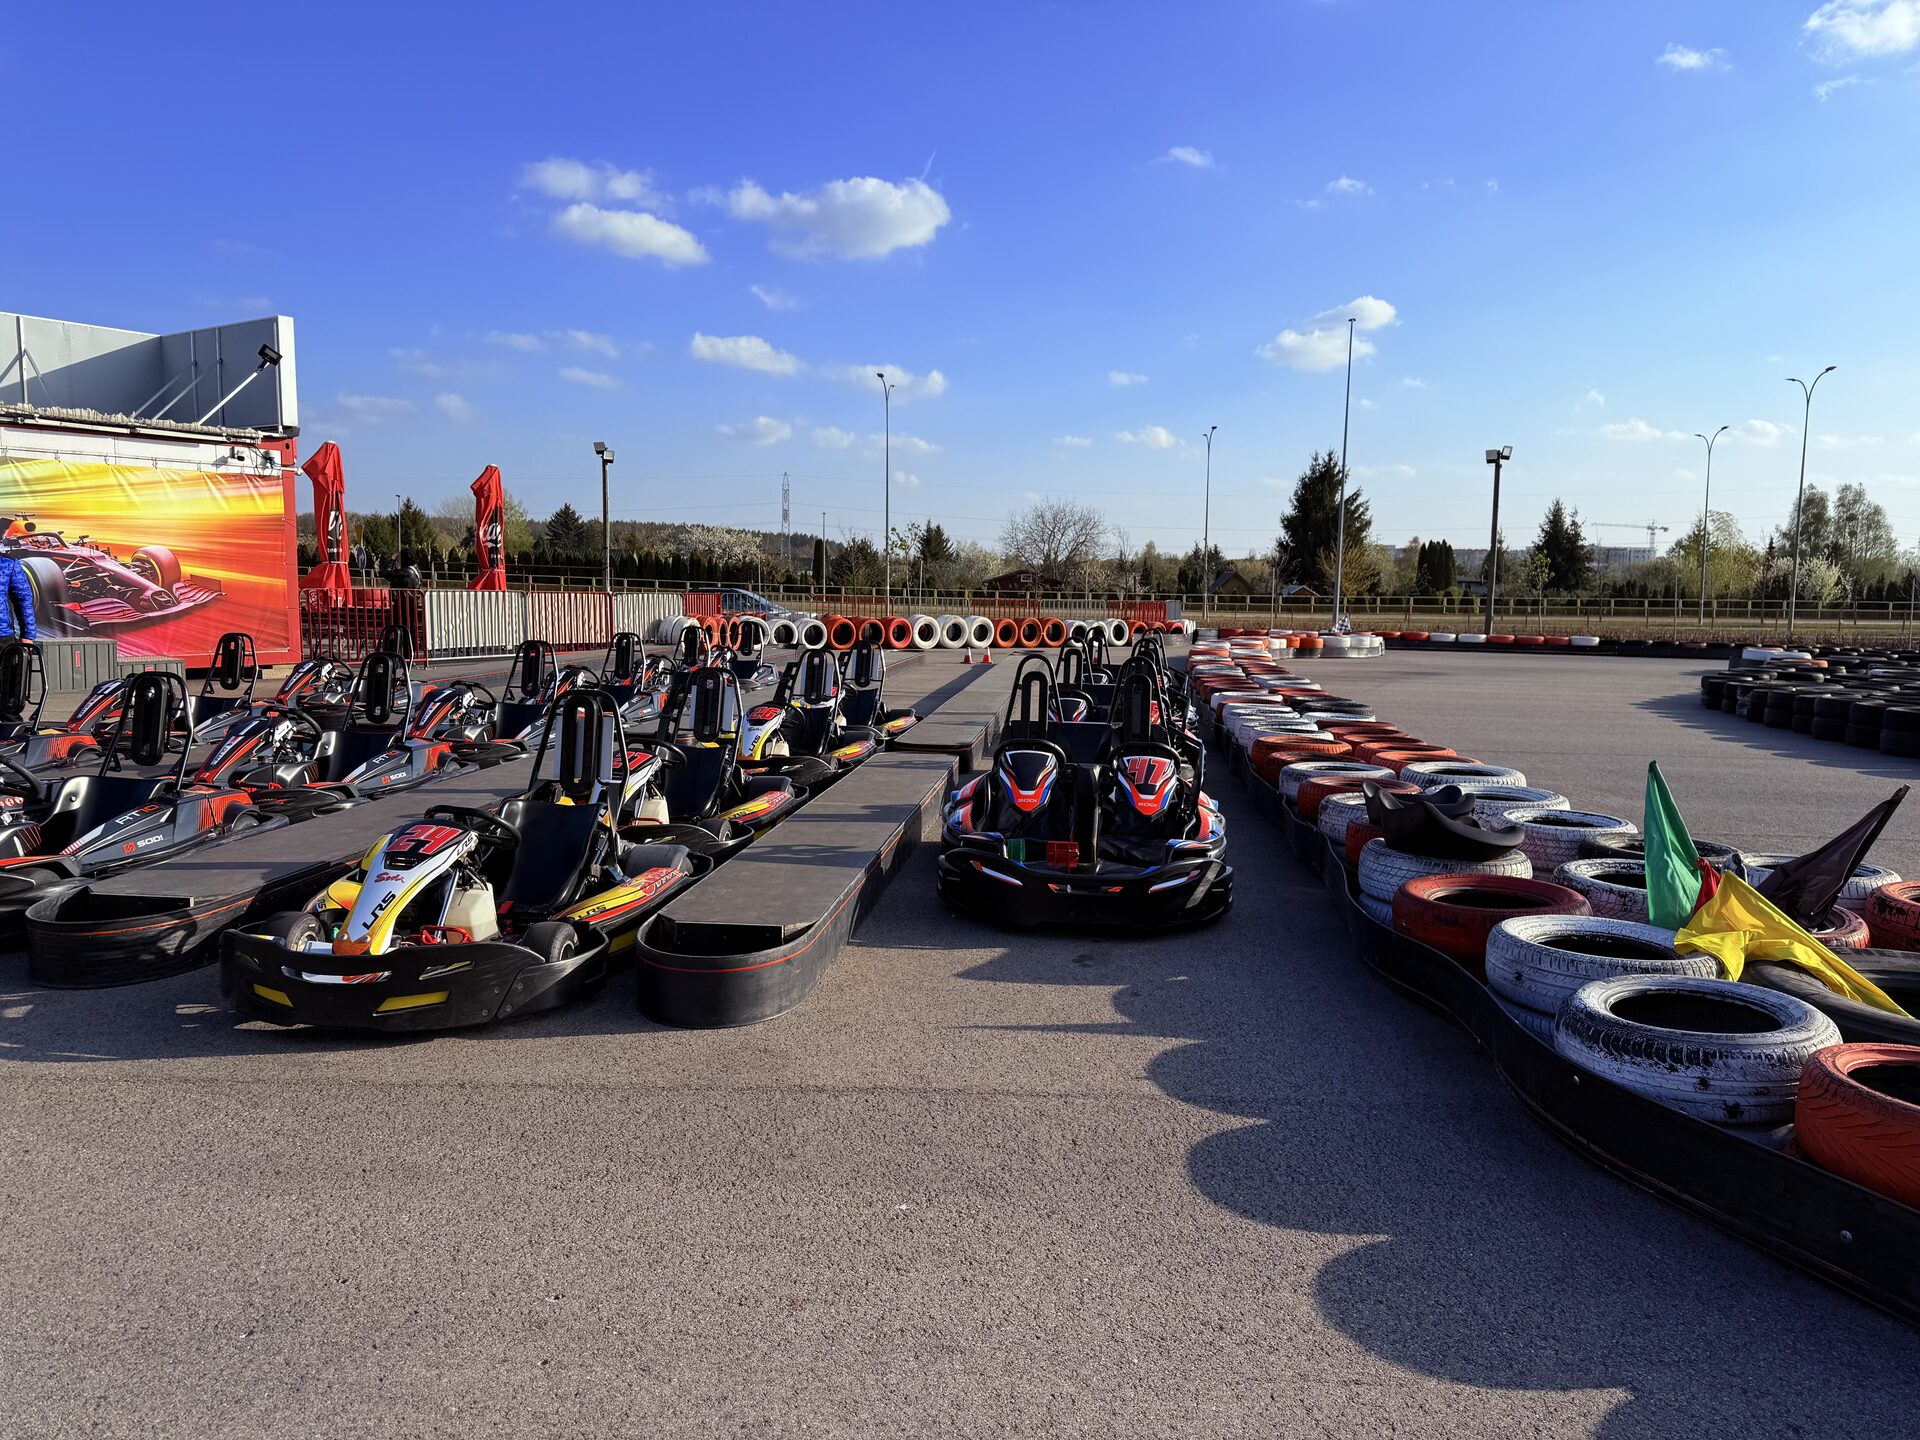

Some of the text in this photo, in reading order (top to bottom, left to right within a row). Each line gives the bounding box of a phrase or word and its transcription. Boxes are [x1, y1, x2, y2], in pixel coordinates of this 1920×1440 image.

[748, 706, 780, 720] 26
[749, 735, 760, 751] LRS
[390, 771, 407, 781] SODI
[1127, 757, 1168, 785] 47
[115, 804, 160, 825] RT10
[137, 834, 164, 848] SODI
[386, 824, 462, 855] 24
[456, 834, 473, 856] LRS
[362, 890, 396, 931] LRS
